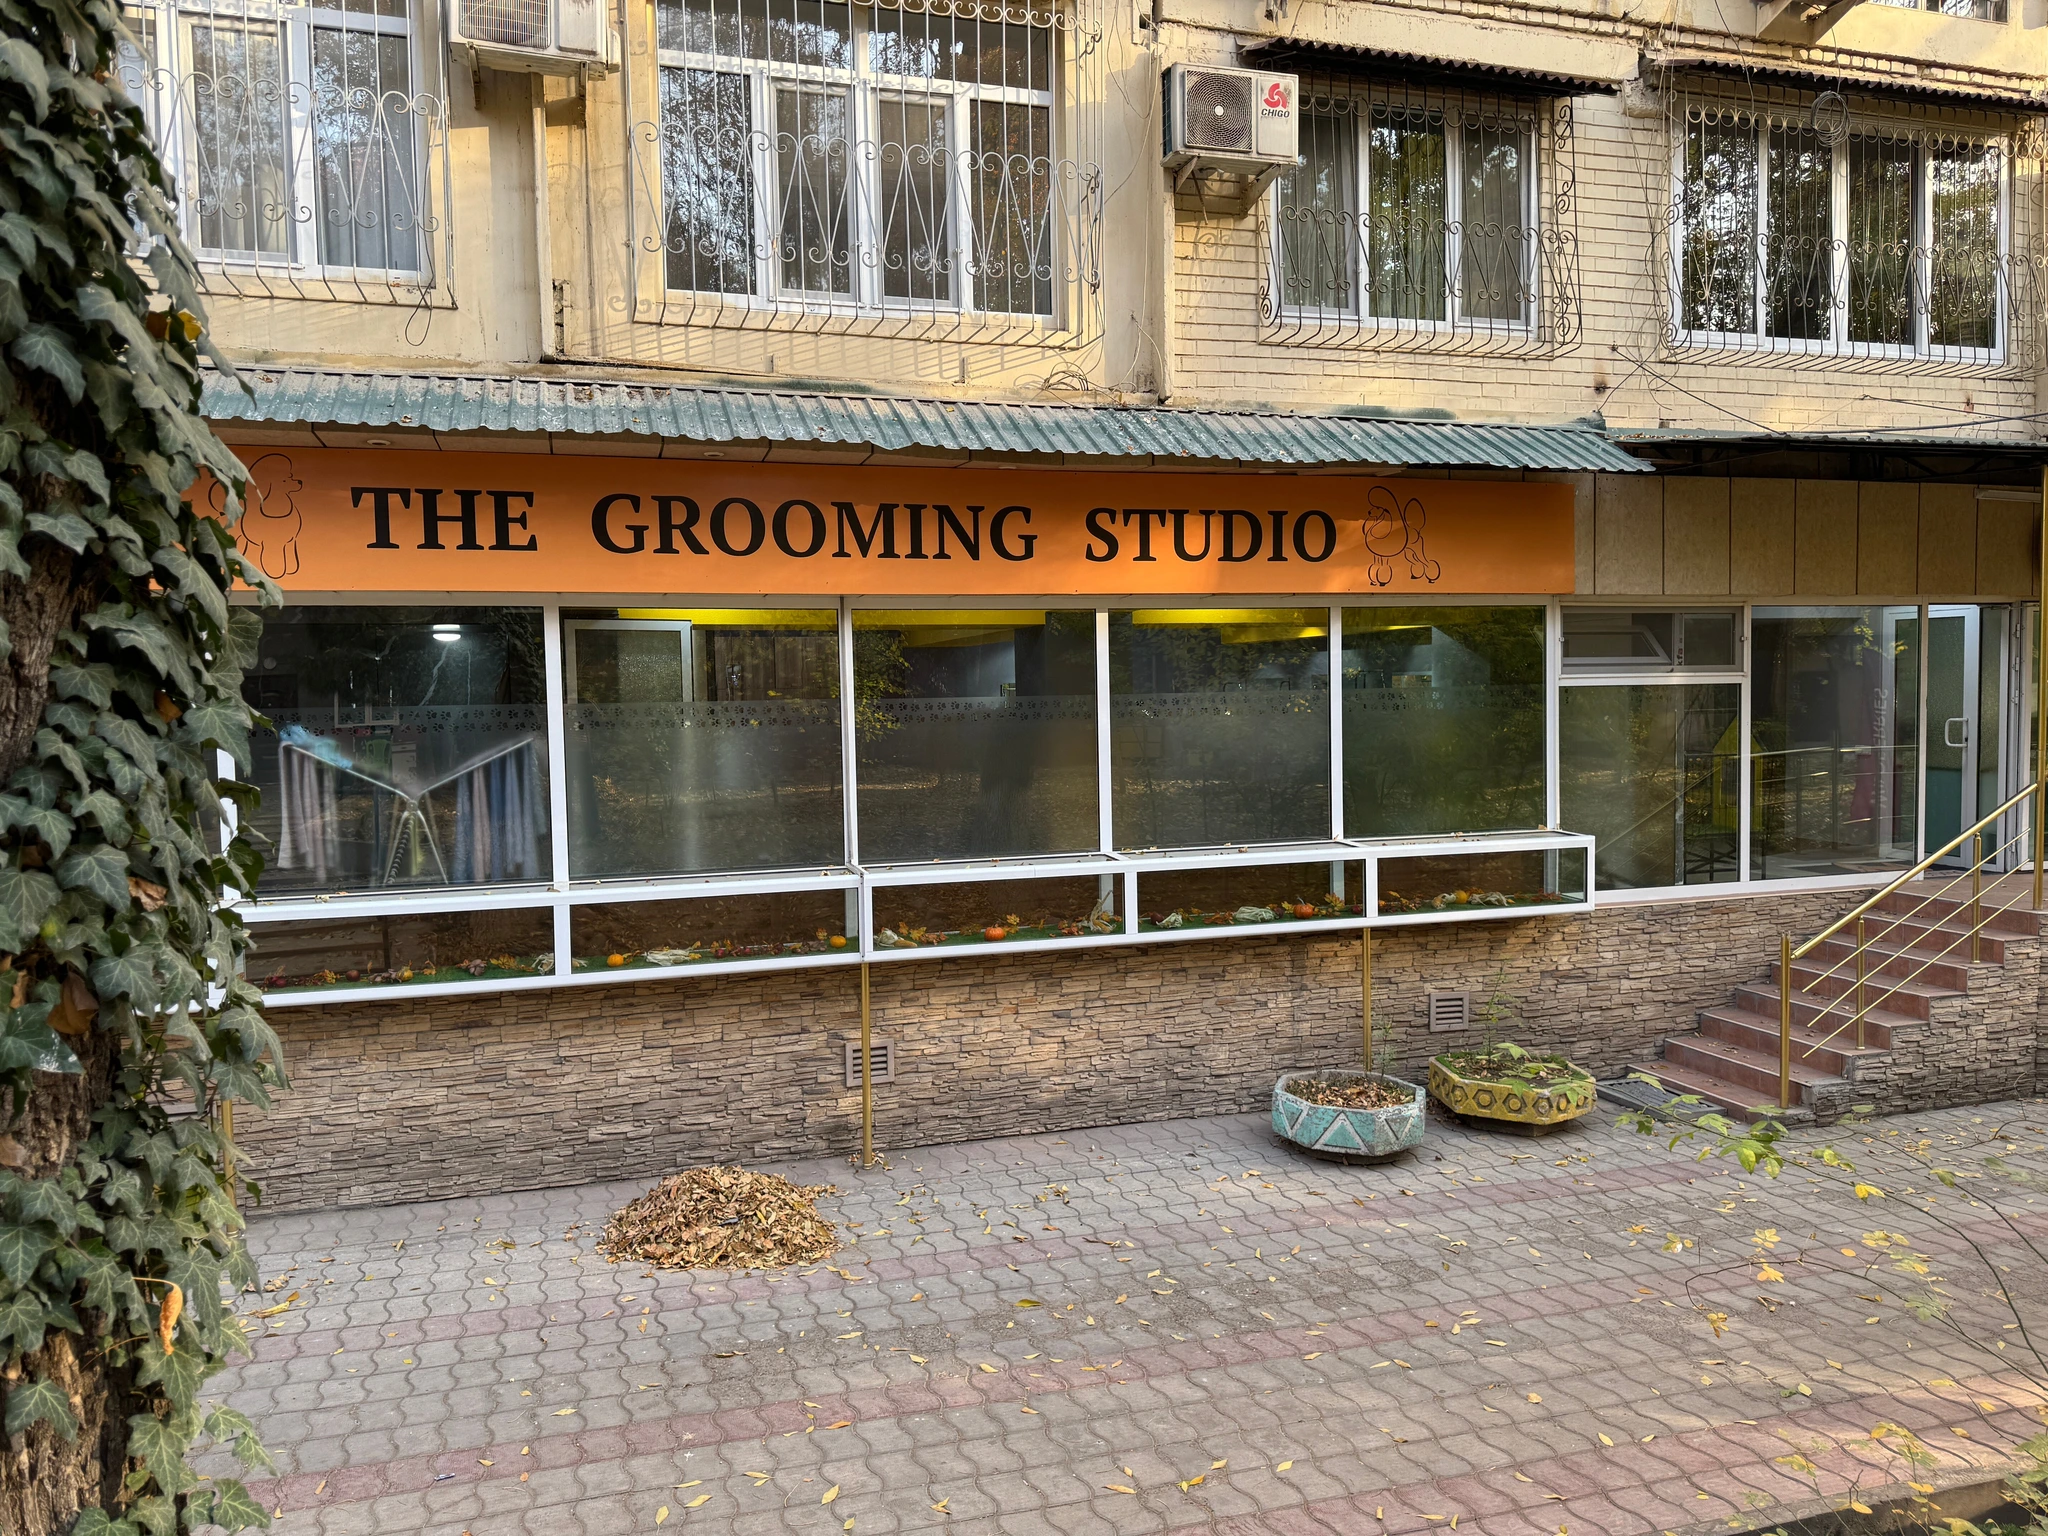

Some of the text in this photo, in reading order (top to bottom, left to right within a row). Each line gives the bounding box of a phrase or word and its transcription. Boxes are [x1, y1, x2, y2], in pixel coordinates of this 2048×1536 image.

[1261, 108, 1290, 118] CHIGO
[351, 487, 1337, 563] THE GROOMING STUDIO
